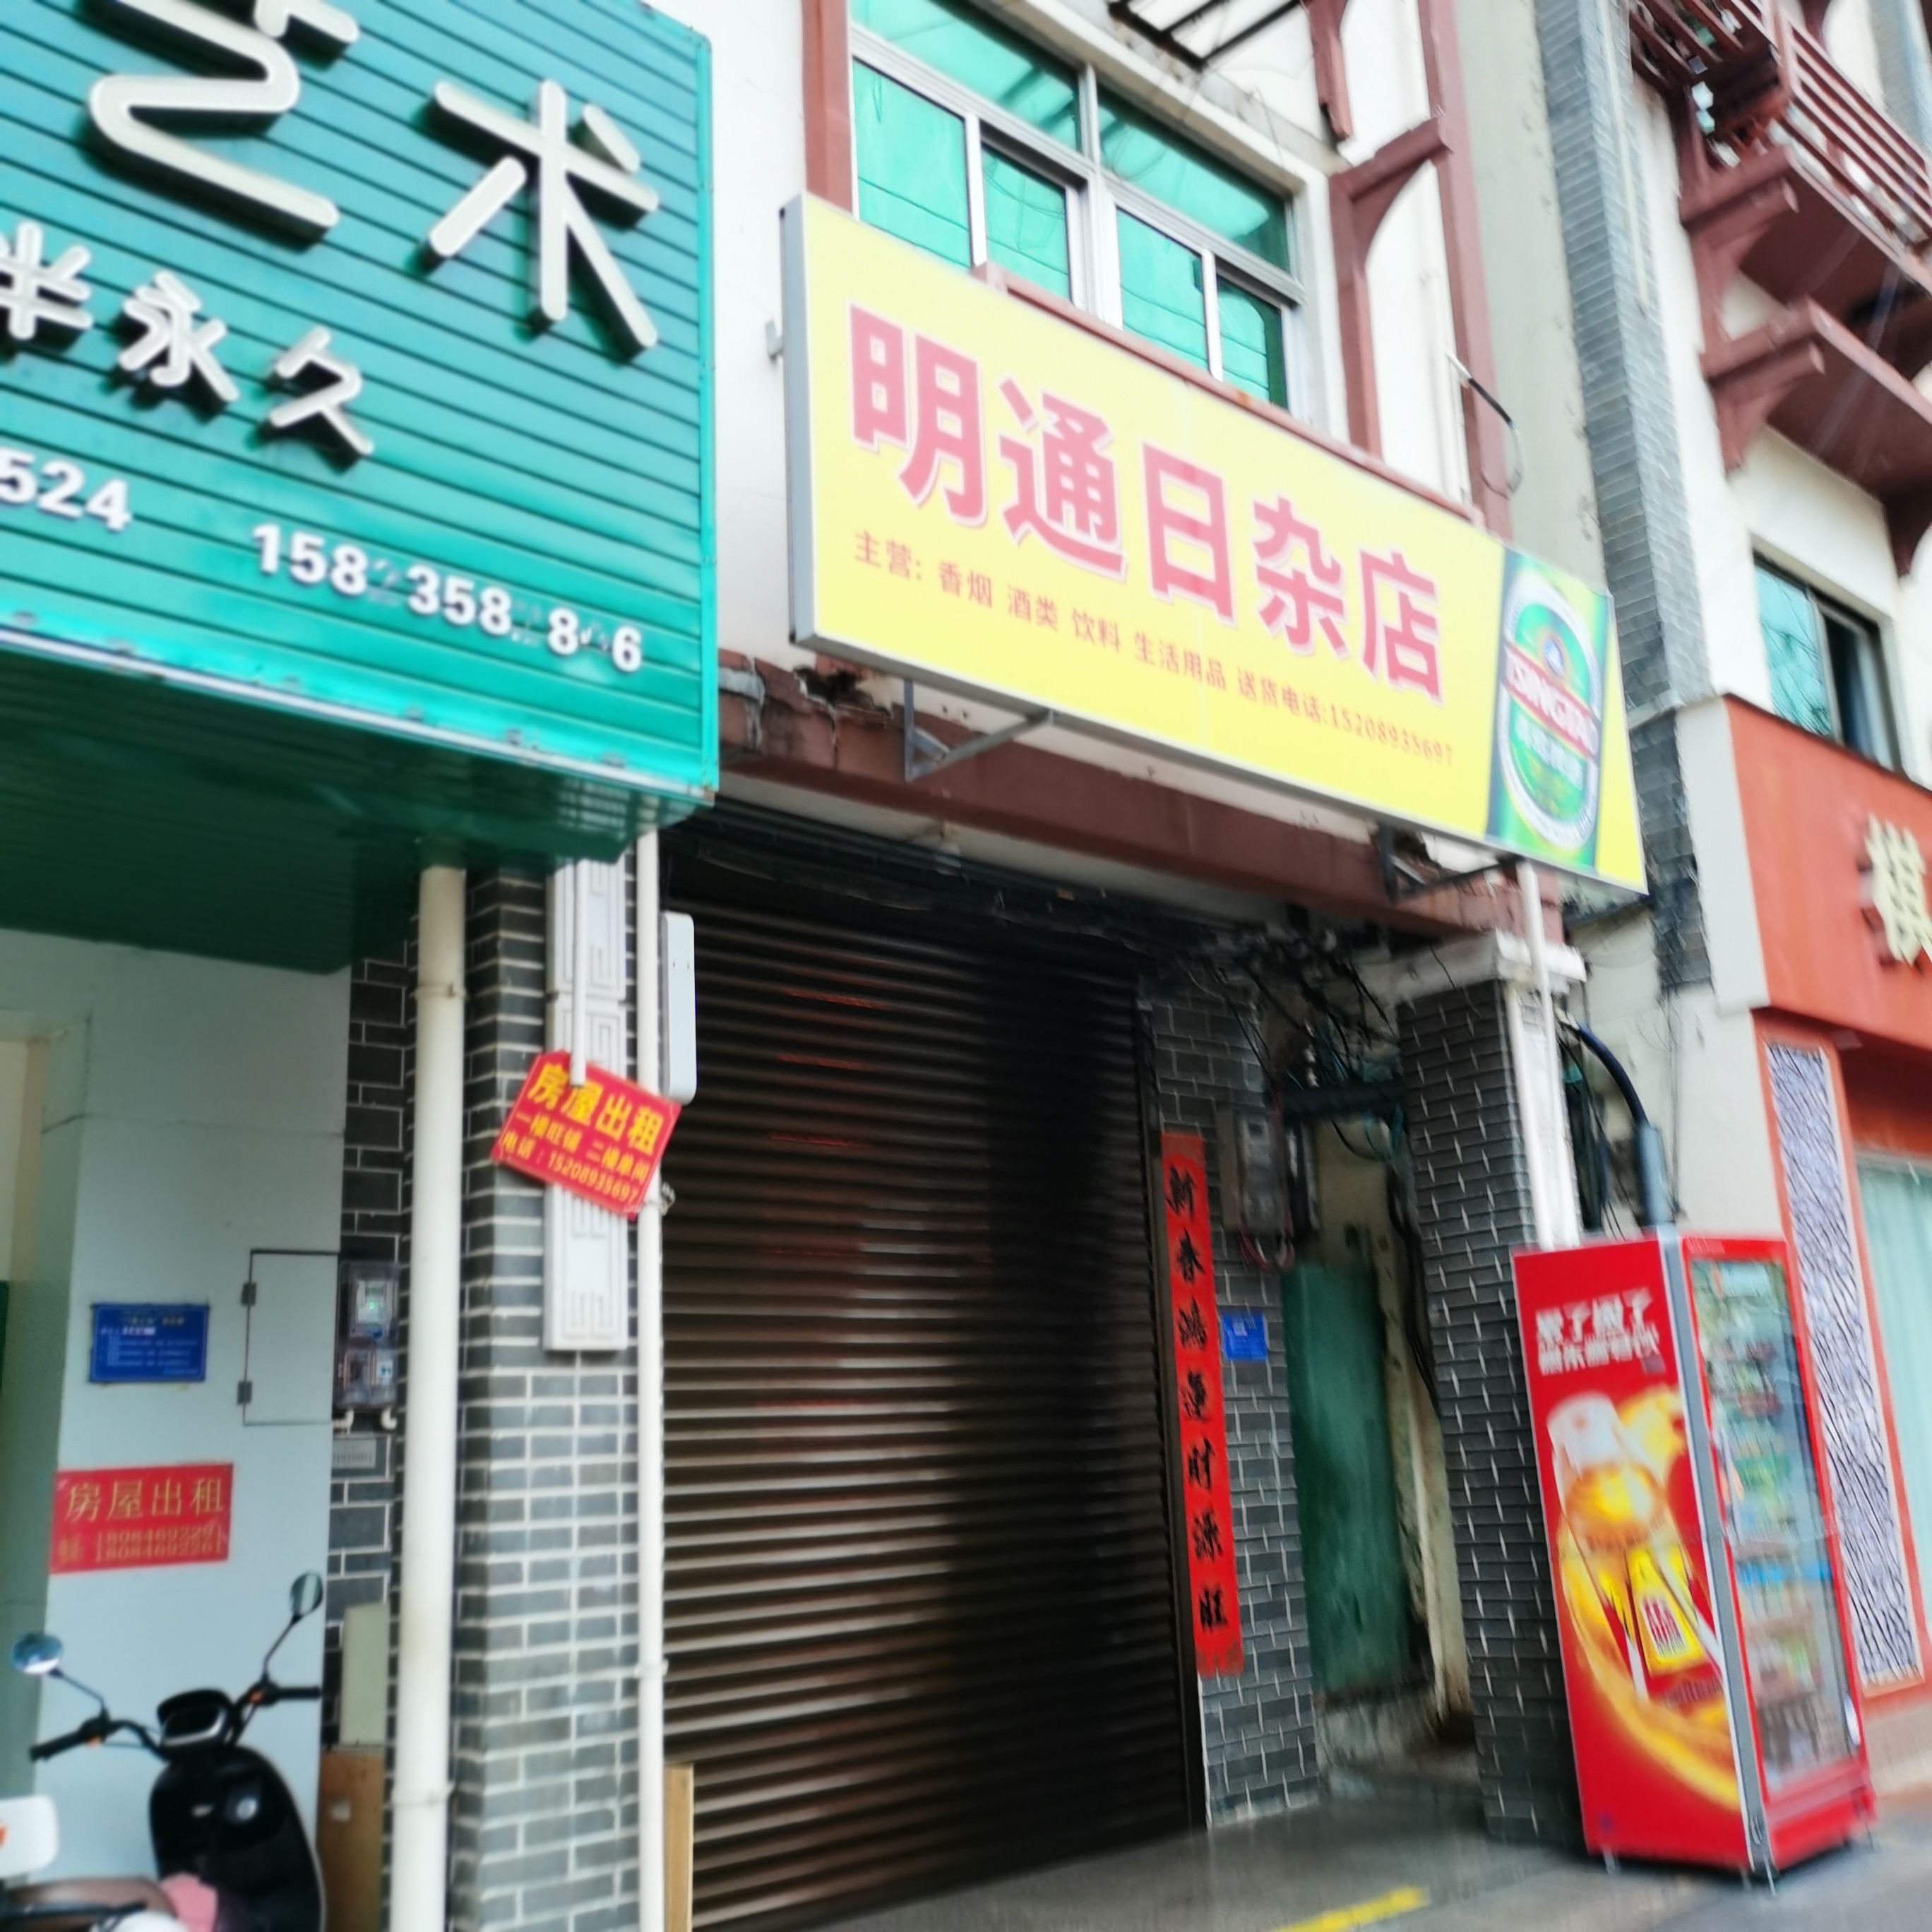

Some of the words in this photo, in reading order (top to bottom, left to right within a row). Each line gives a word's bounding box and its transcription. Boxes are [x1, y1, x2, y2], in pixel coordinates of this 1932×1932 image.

[90, 0, 660, 348] 艺术
[0, 222, 374, 455] 半永久
[849, 304, 1443, 703] 明通日杂店
[939, 561, 992, 609] 香烟
[1007, 584, 1059, 632] 酒类
[1072, 607, 1121, 653] 饮料
[1134, 631, 1227, 691] 生活用品
[527, 1062, 664, 1156] 房屋出租
[66, 1476, 225, 1522] 房屋出租
